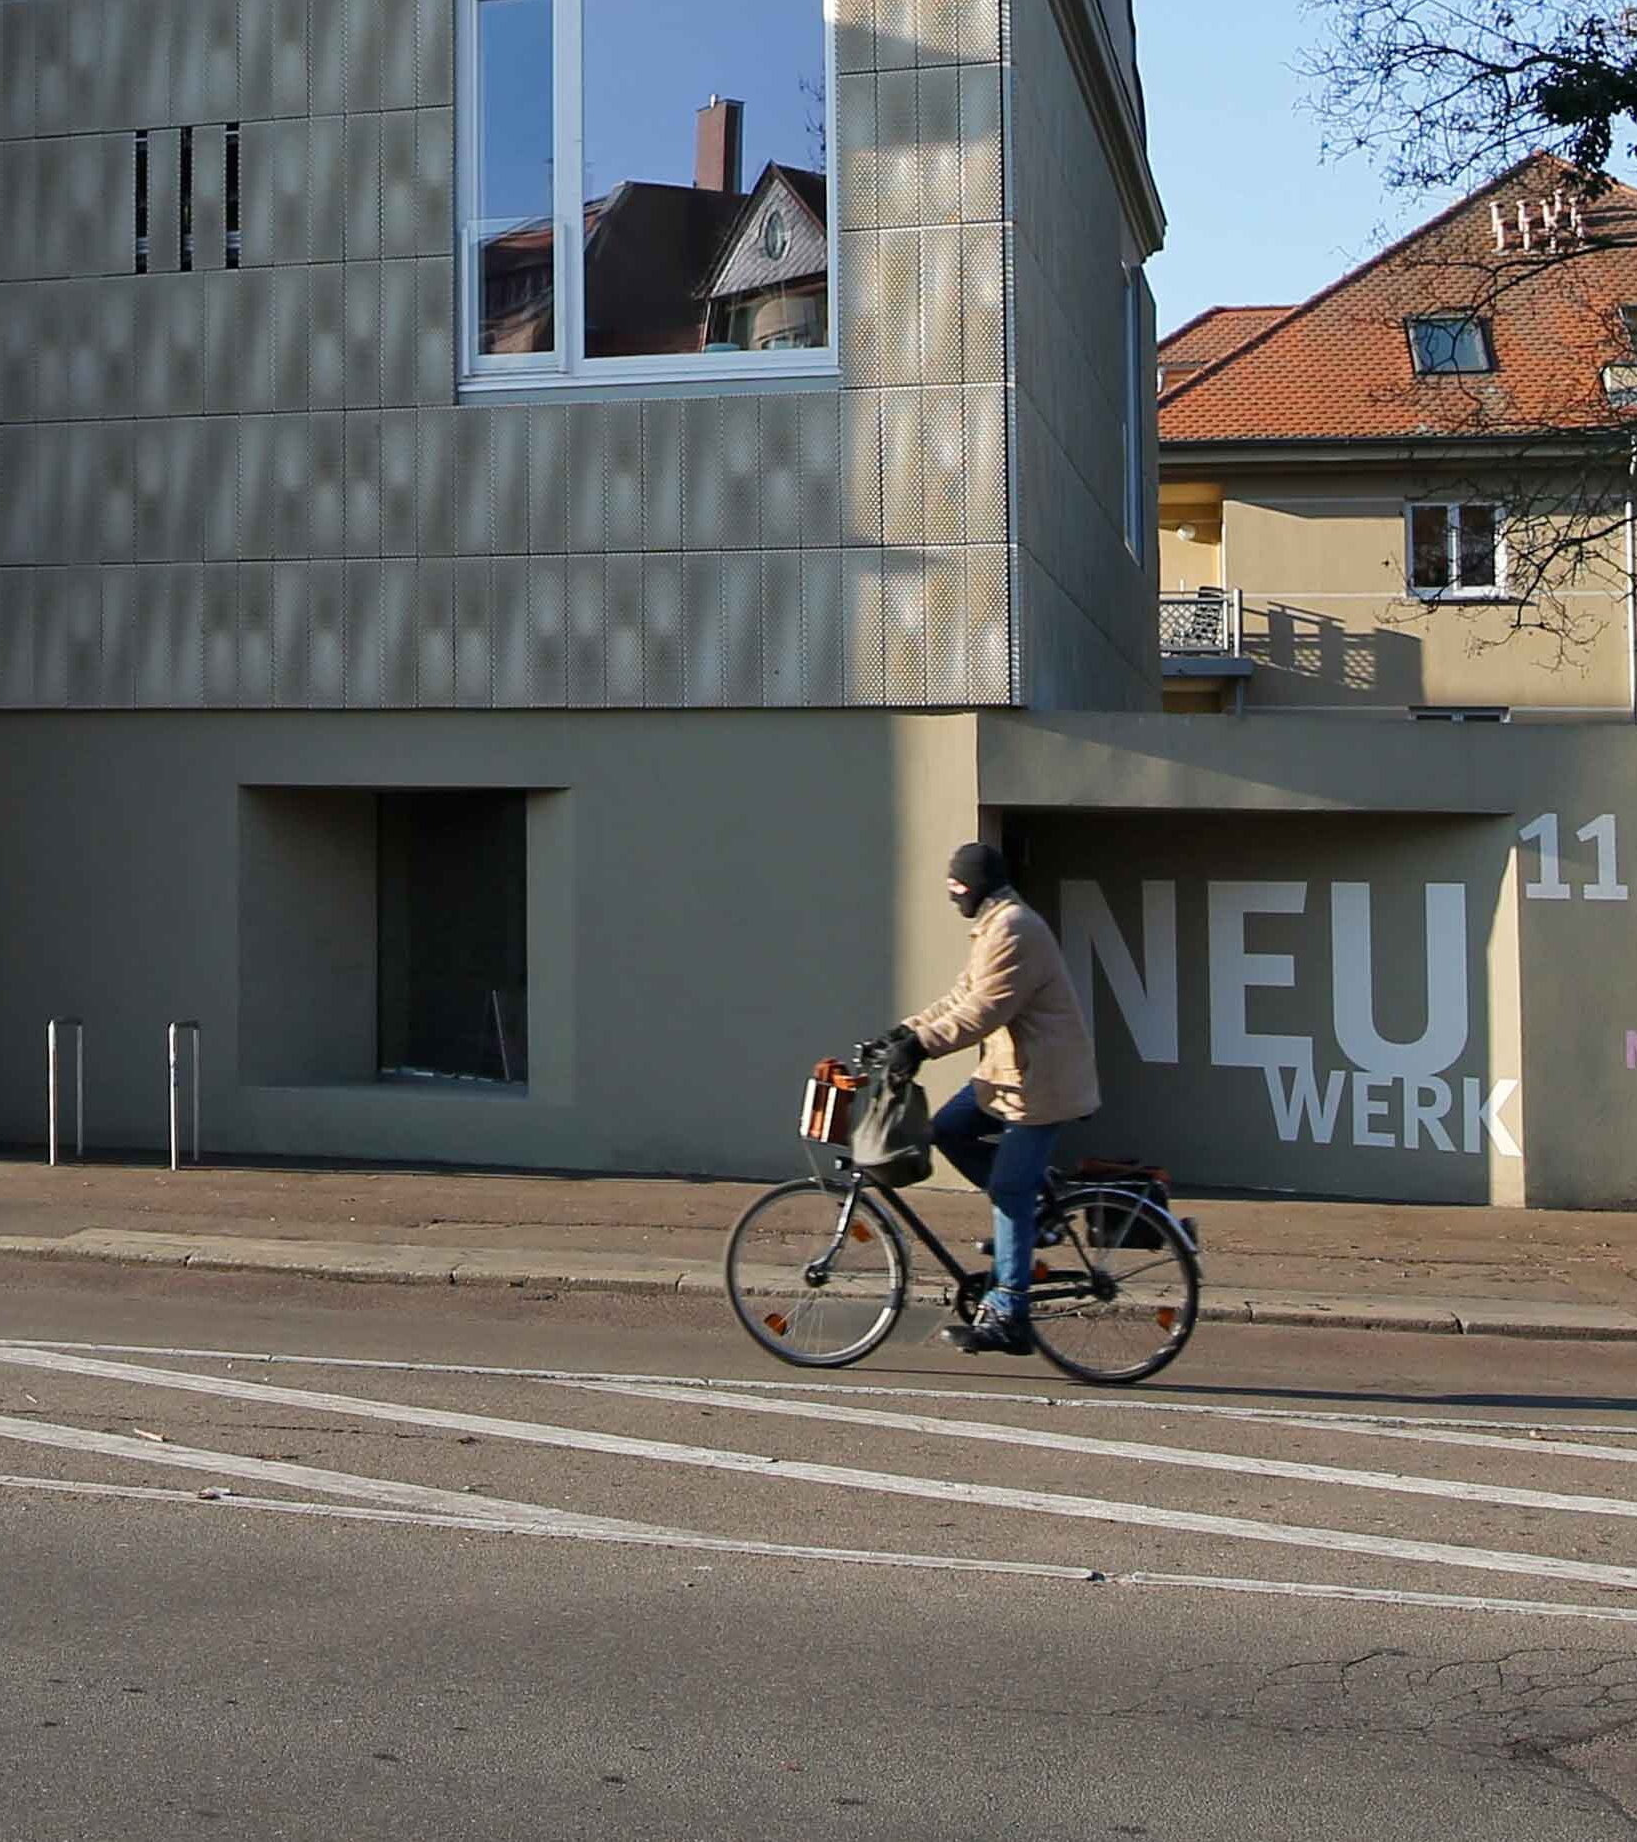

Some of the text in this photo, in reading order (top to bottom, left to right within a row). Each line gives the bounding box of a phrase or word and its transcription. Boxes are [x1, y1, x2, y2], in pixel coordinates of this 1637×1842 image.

[1518, 813, 1629, 901] 11
[1060, 880, 1469, 1074] NEU
[1263, 1067, 1523, 1157] WERK
